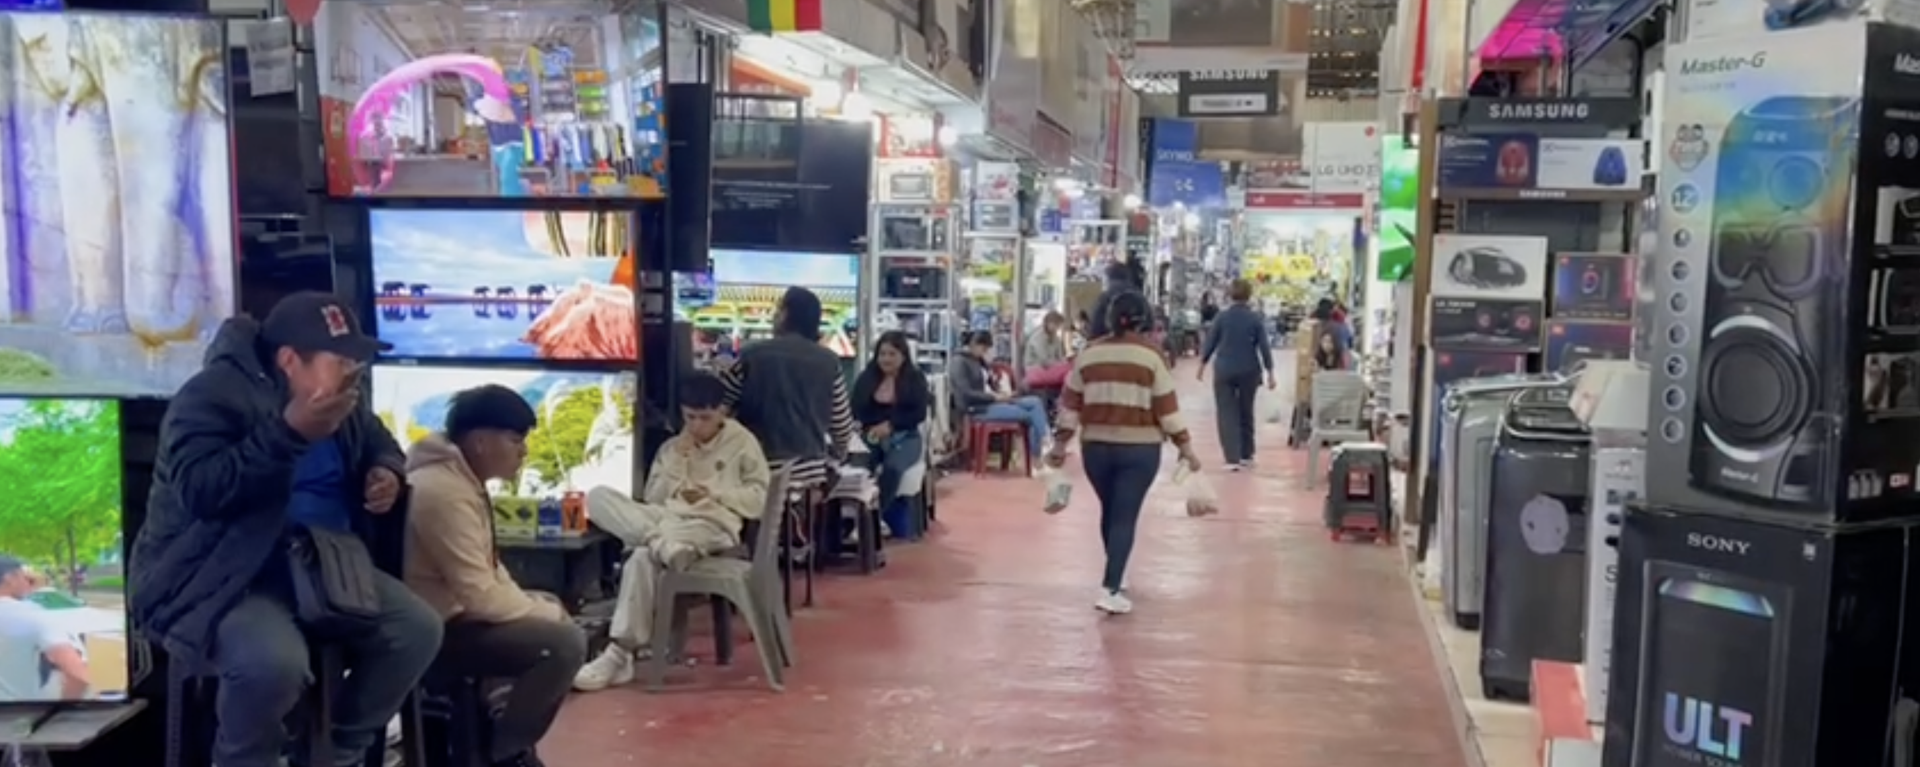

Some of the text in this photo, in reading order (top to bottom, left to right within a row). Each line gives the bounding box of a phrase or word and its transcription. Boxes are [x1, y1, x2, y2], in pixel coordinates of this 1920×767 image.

[1681, 51, 1767, 75] Master-G
[1489, 103, 1588, 119] SAMSUNG
[1318, 164, 1334, 176] LG
[1686, 532, 1750, 555] SONY
[1664, 691, 1753, 760] ULT
